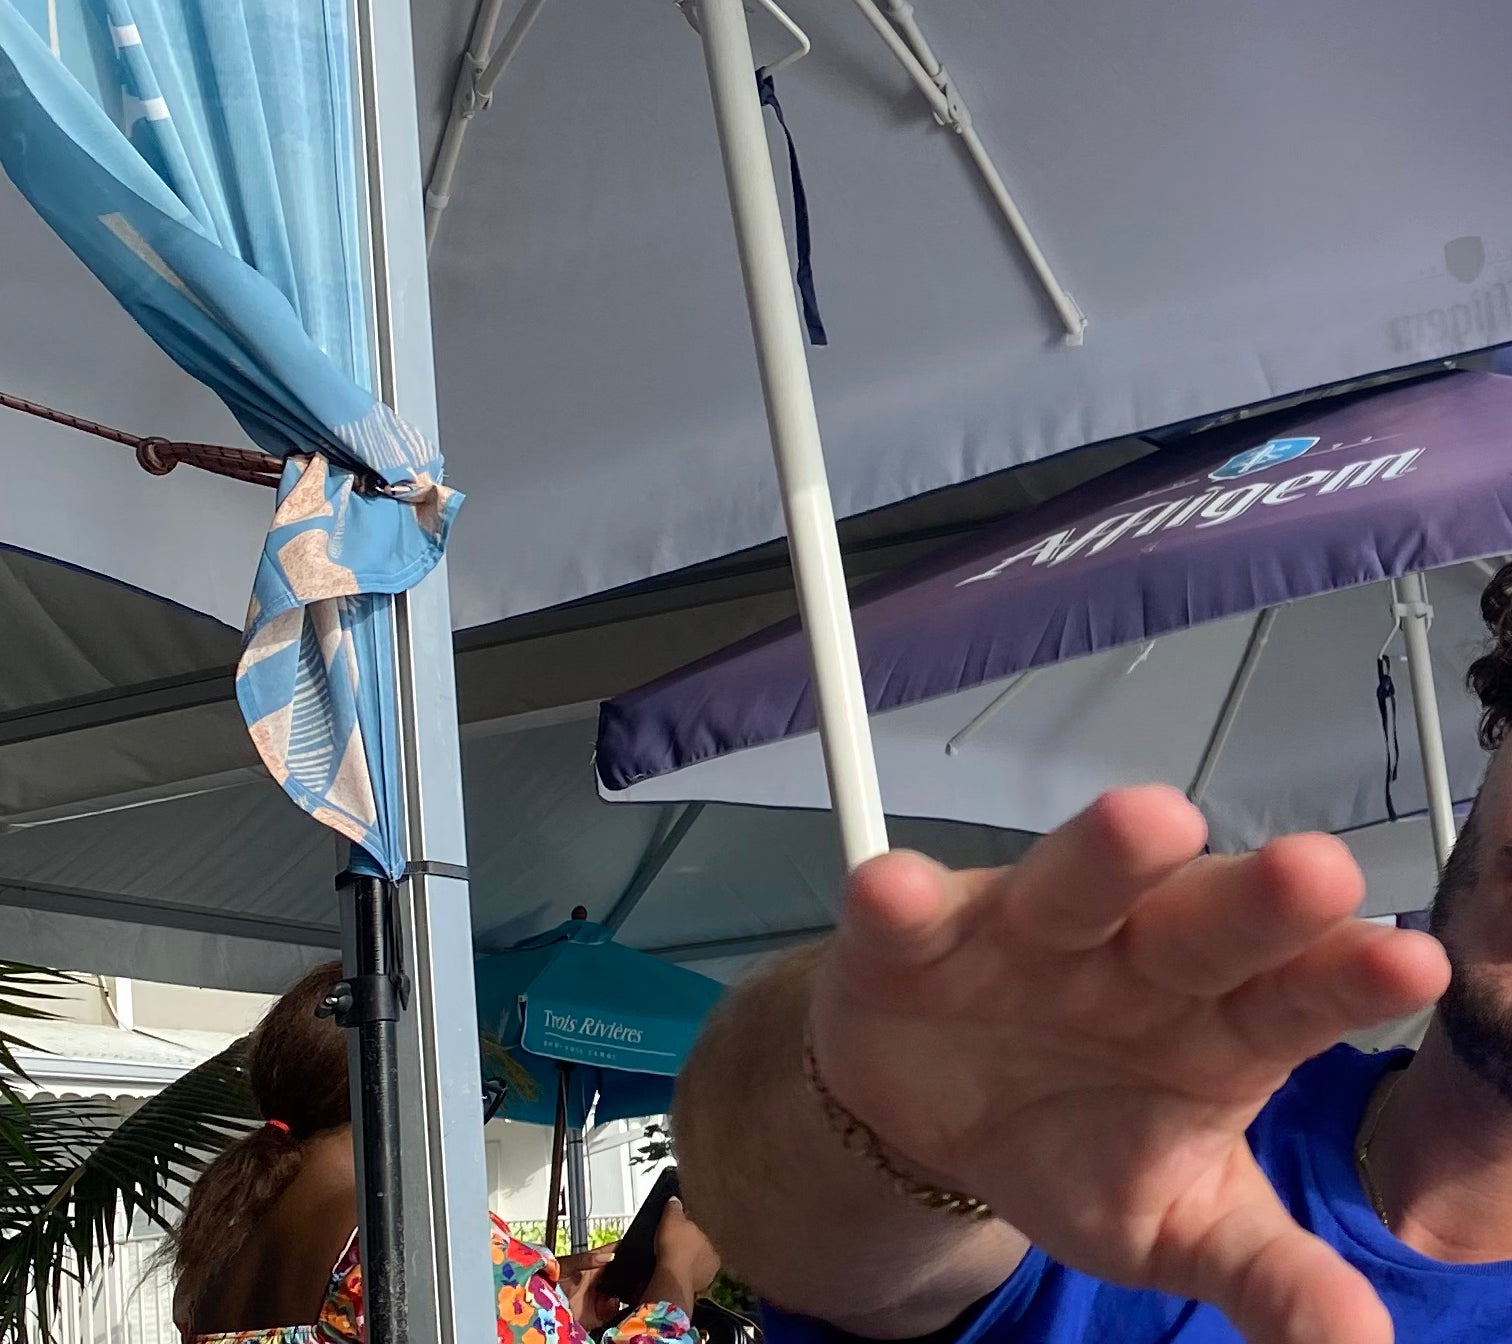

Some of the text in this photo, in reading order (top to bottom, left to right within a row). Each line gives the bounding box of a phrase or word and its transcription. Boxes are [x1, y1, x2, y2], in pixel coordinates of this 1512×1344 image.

[954, 447, 1427, 588] Affligem
[543, 1009, 644, 1044] Trois Rivières
